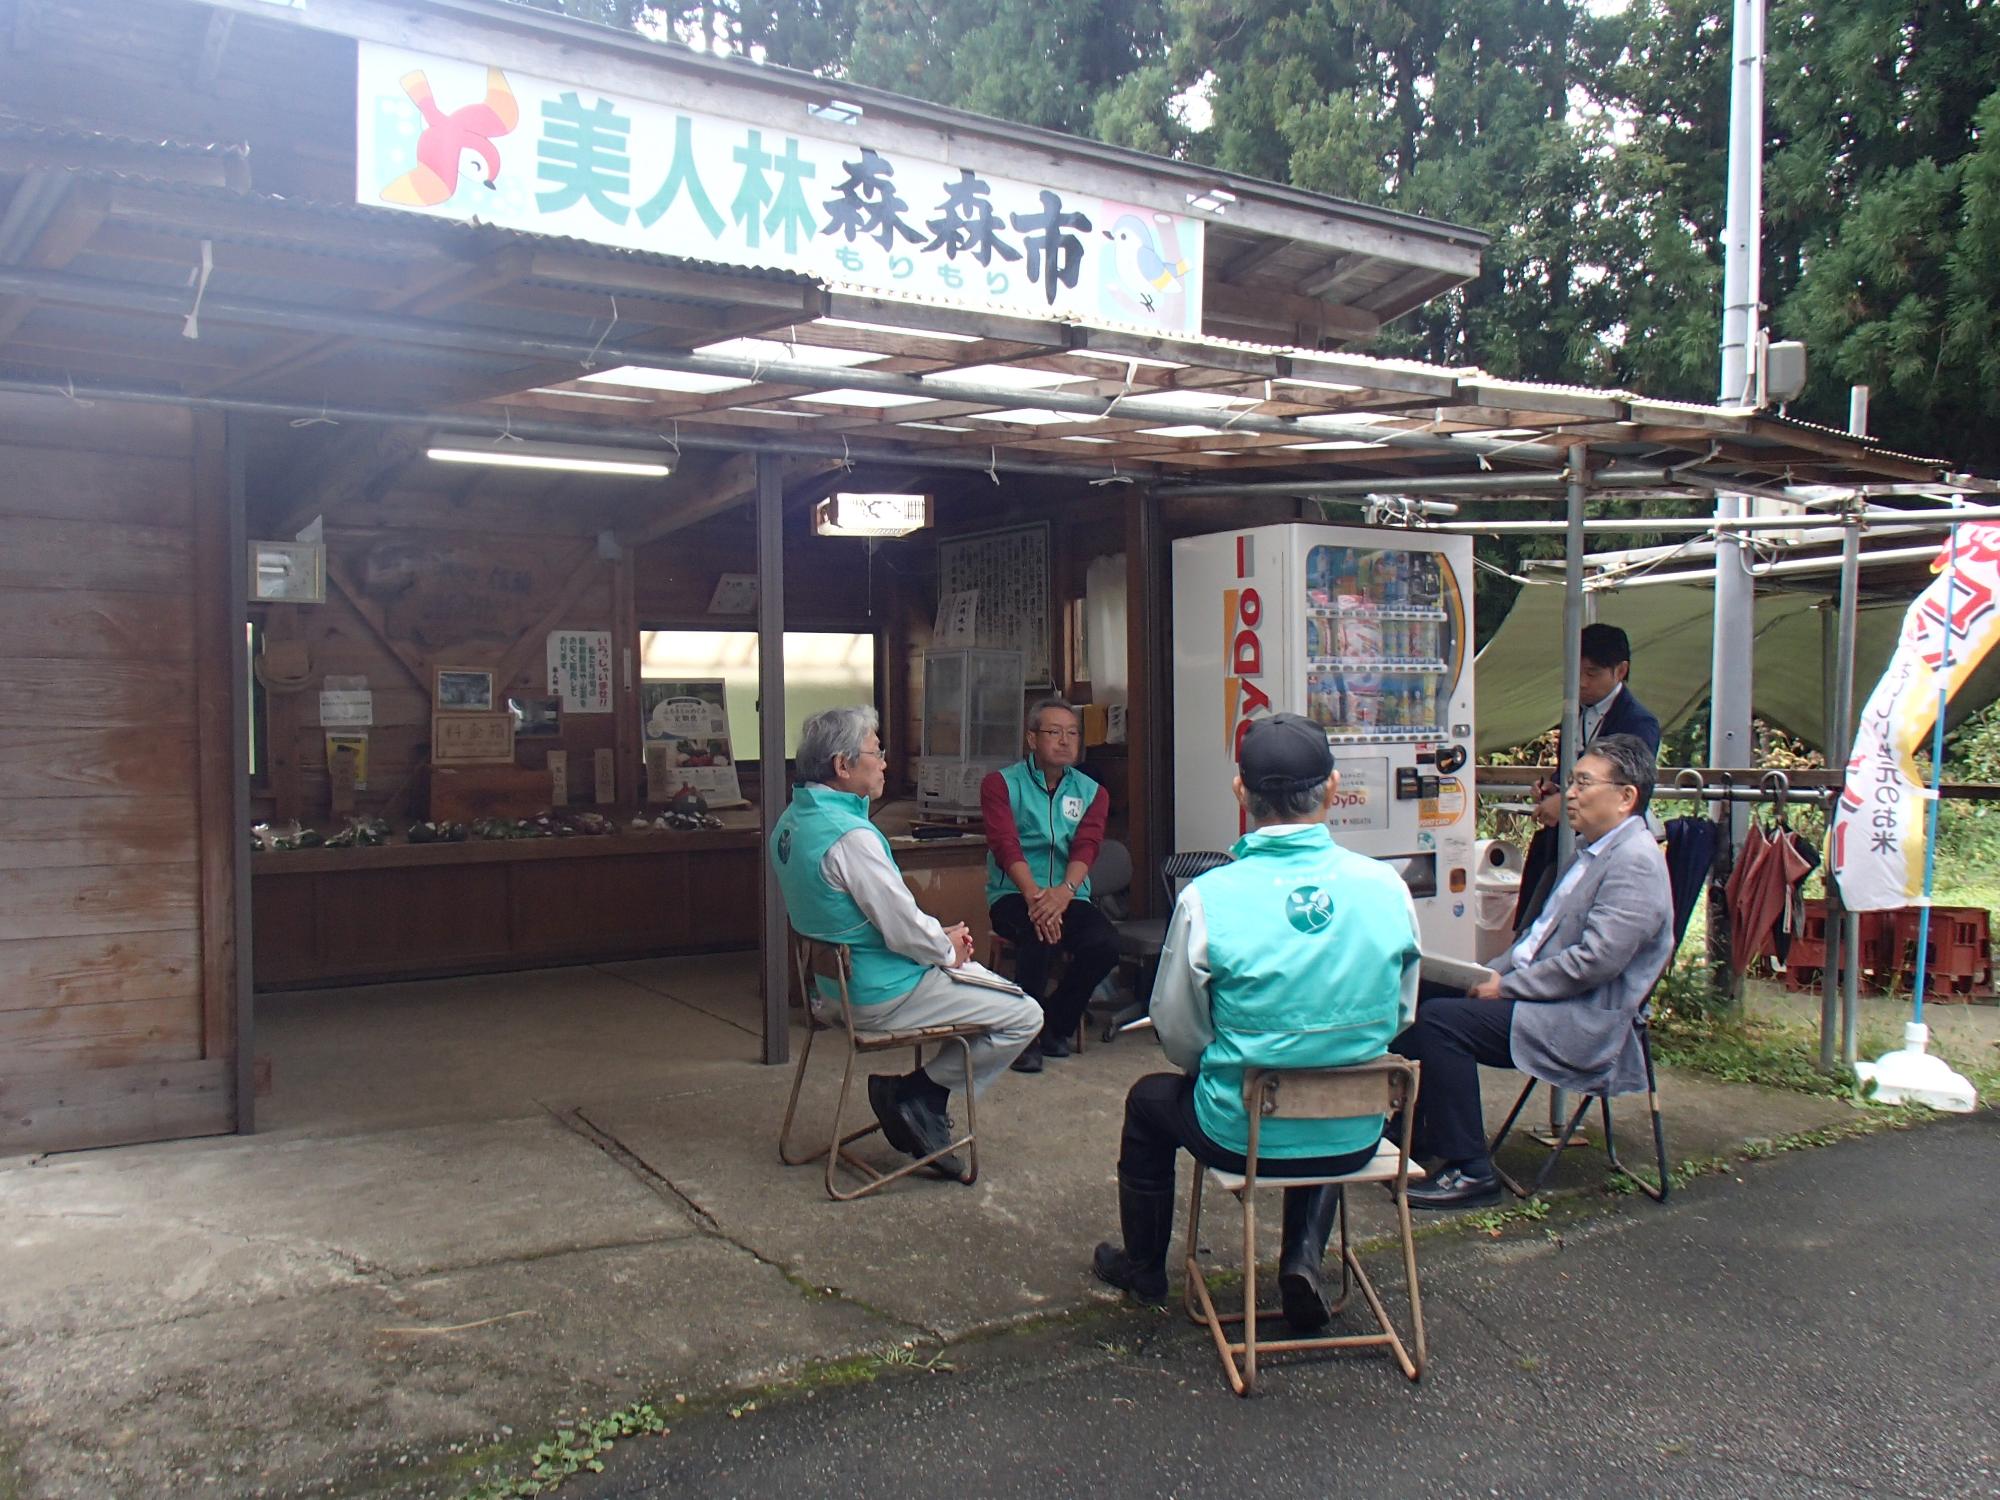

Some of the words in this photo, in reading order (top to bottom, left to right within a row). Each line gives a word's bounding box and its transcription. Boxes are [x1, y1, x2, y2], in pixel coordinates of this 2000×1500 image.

[533, 91, 1093, 306] 美人林森森市
[834, 245, 1010, 295] もりもり
